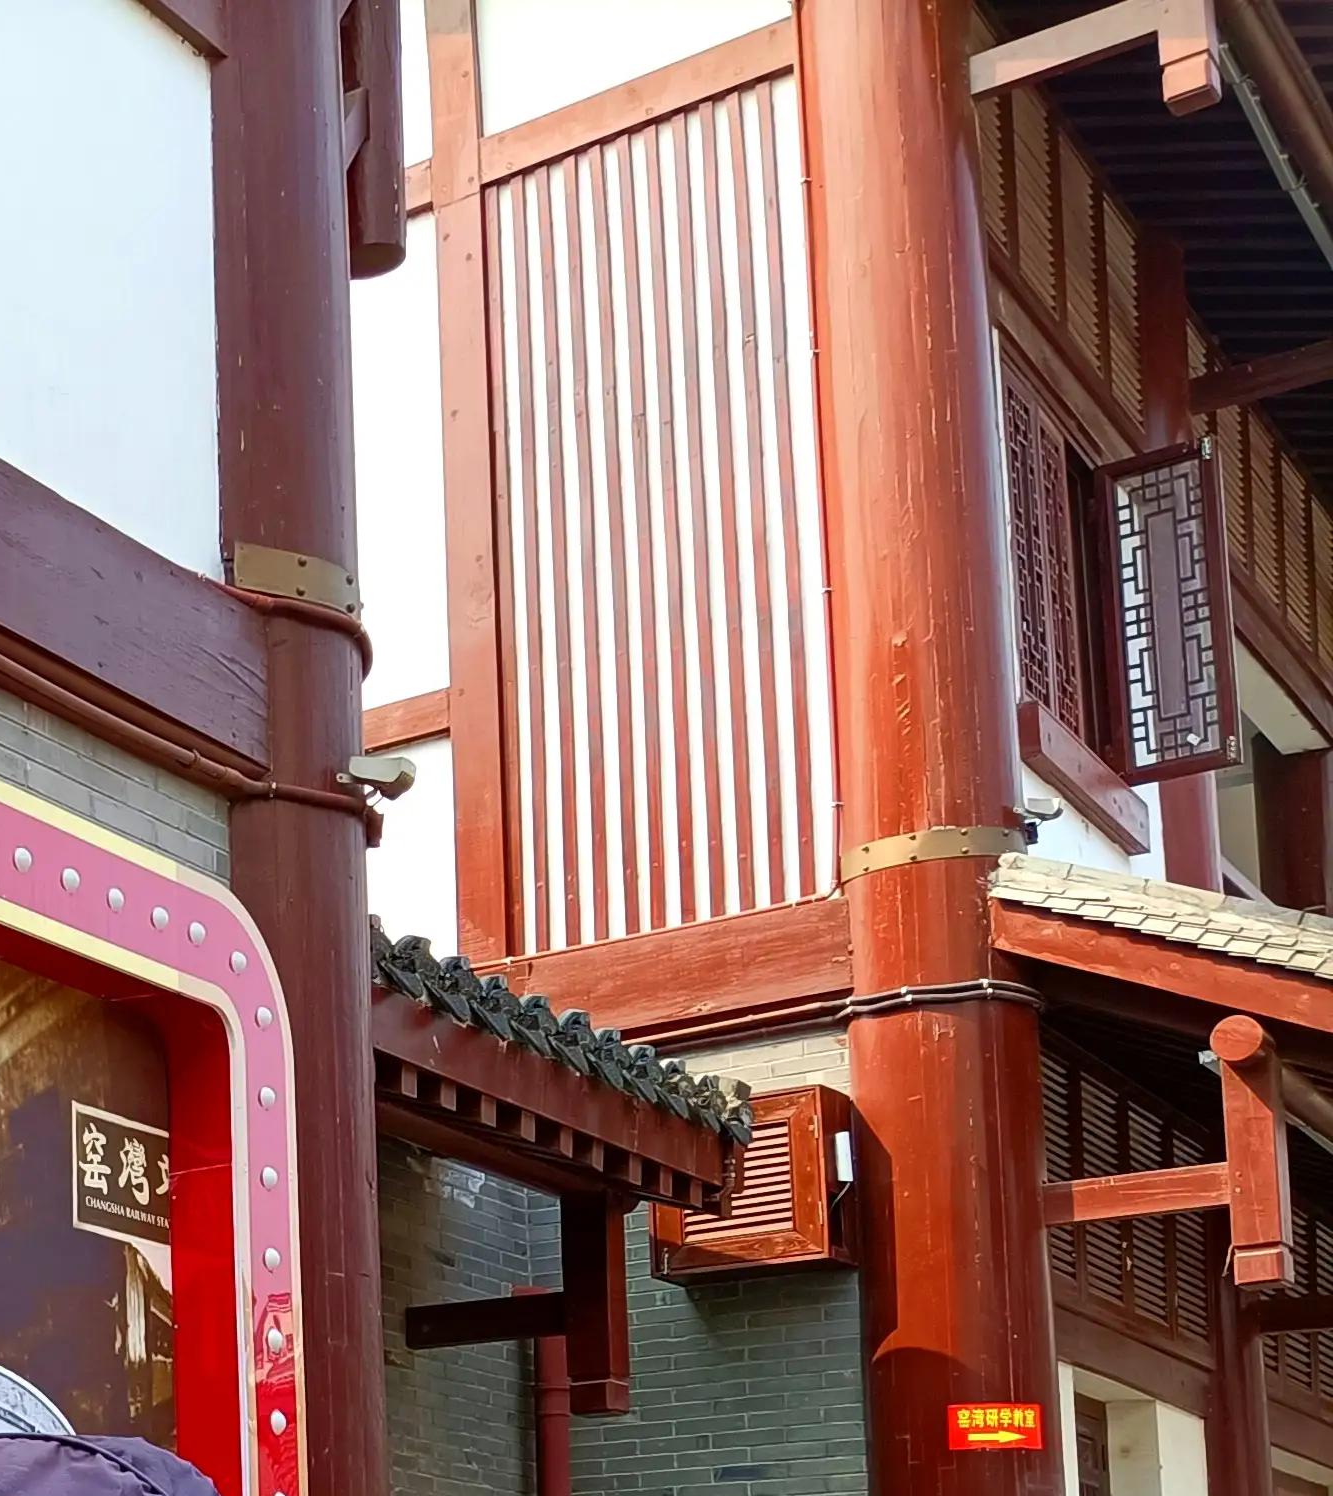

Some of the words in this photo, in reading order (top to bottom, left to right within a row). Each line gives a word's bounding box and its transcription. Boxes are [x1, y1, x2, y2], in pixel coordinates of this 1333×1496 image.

[85, 1196, 125, 1216] CHANGSHA
[126, 1207, 156, 1225] RAILWAY
[157, 1216, 170, 1229] STA
